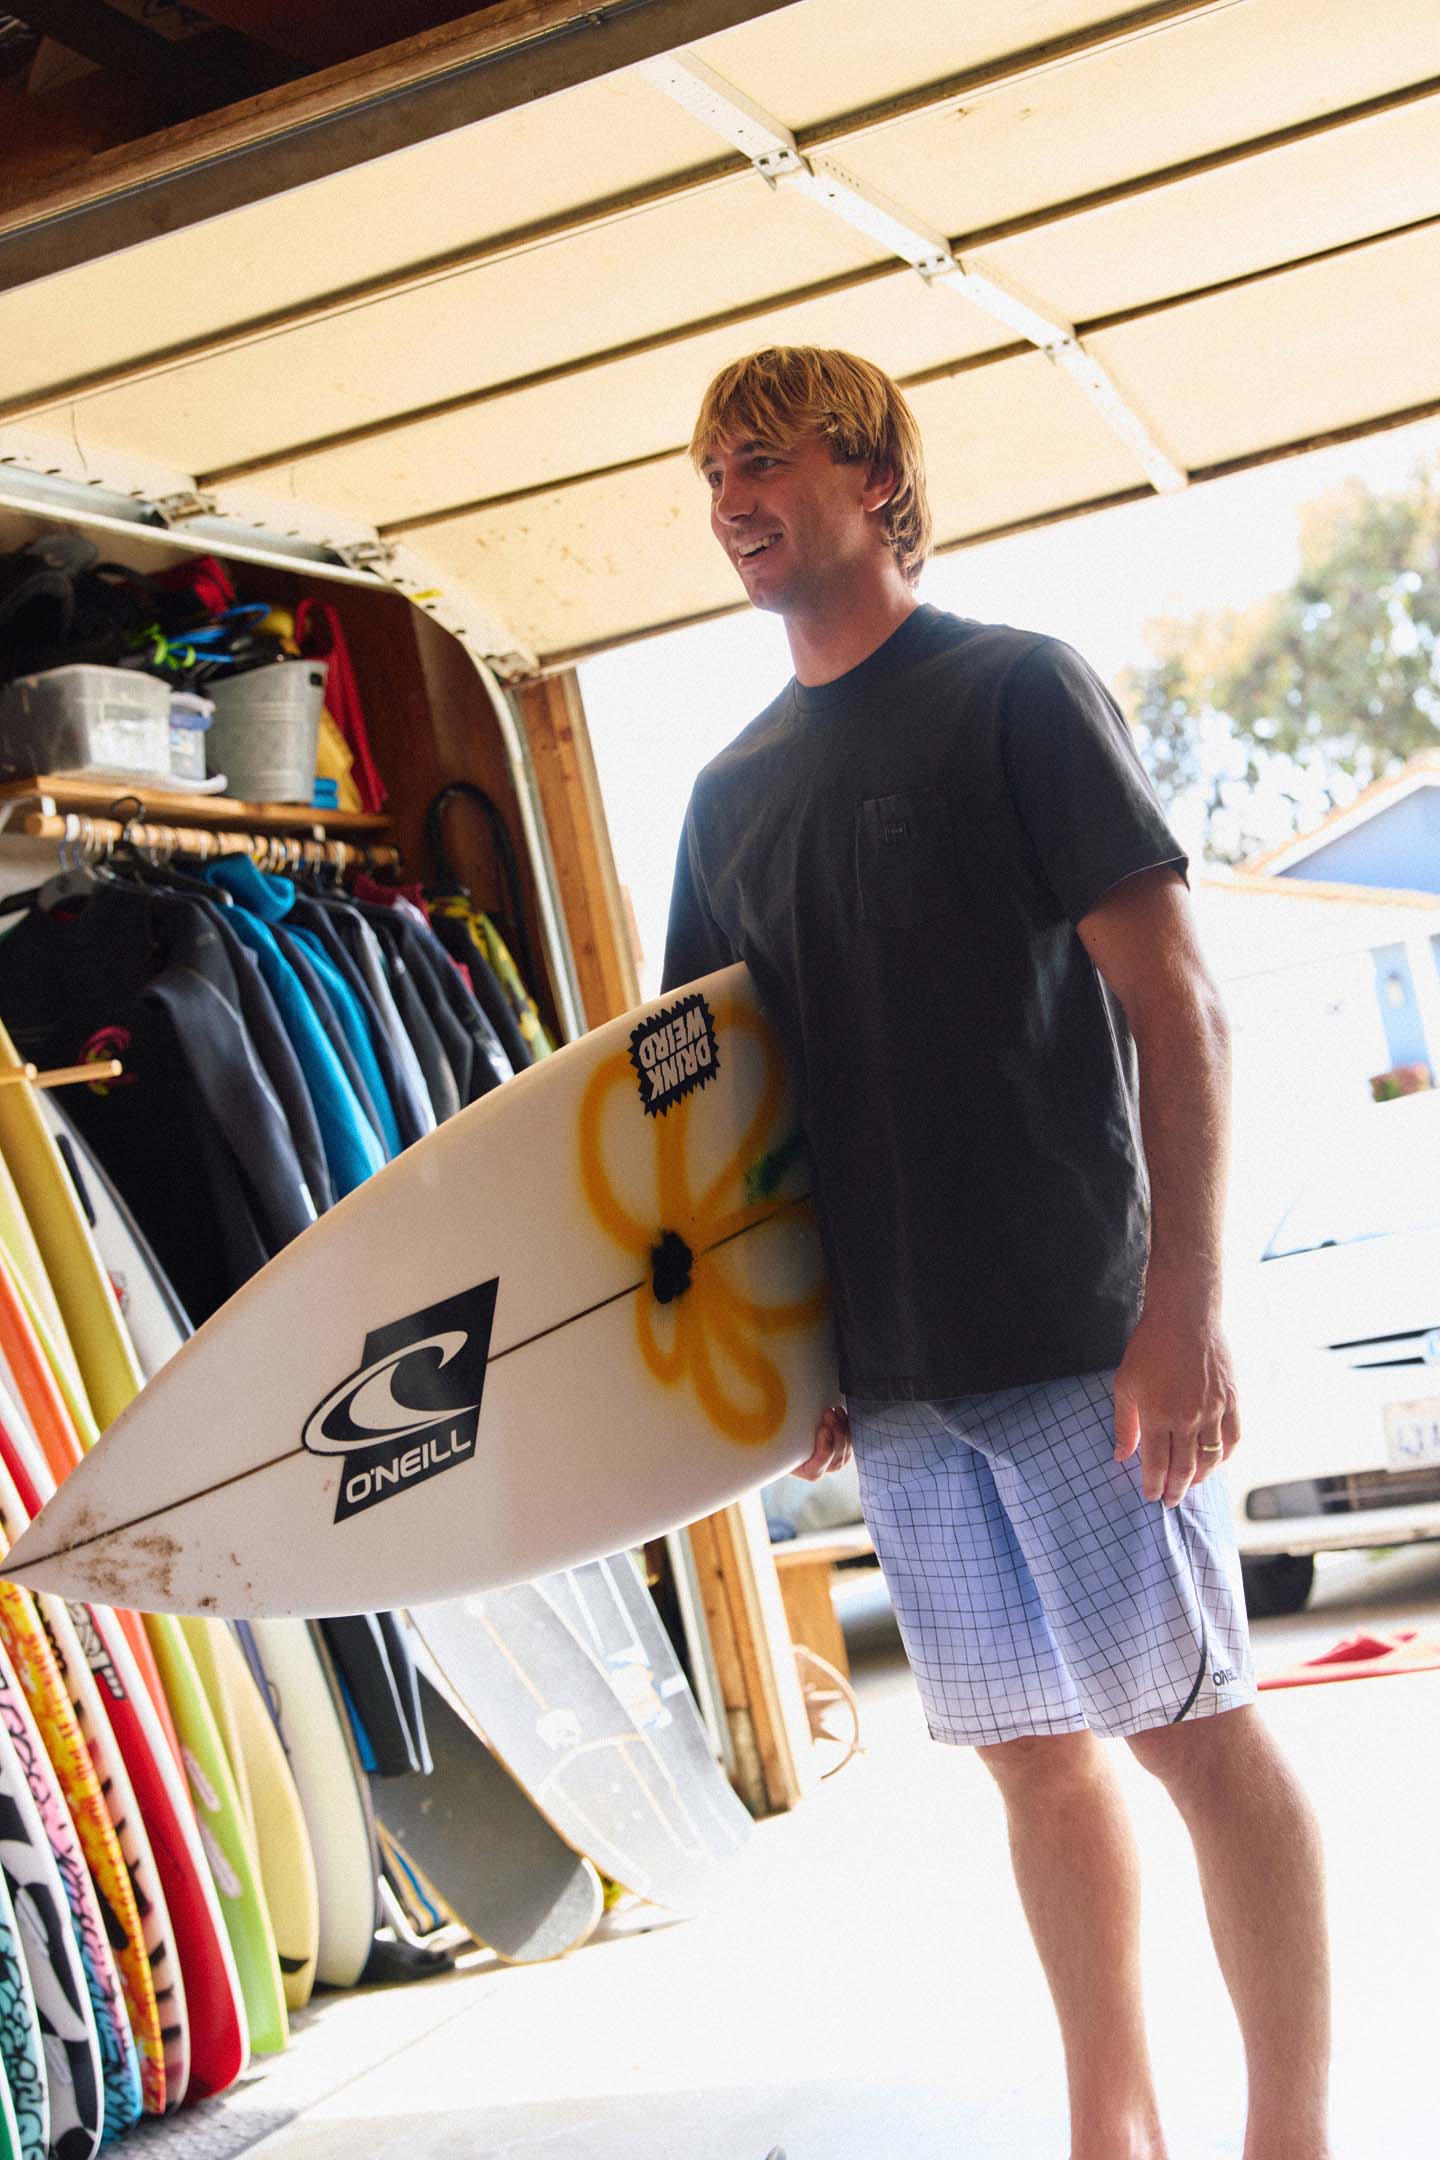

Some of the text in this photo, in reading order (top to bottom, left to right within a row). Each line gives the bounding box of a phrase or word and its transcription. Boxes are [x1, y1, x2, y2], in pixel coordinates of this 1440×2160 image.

[638, 1006, 707, 1069] WEIRD
[646, 1034, 712, 1101] DRINK
[345, 1429, 472, 1504] O'NEILL
